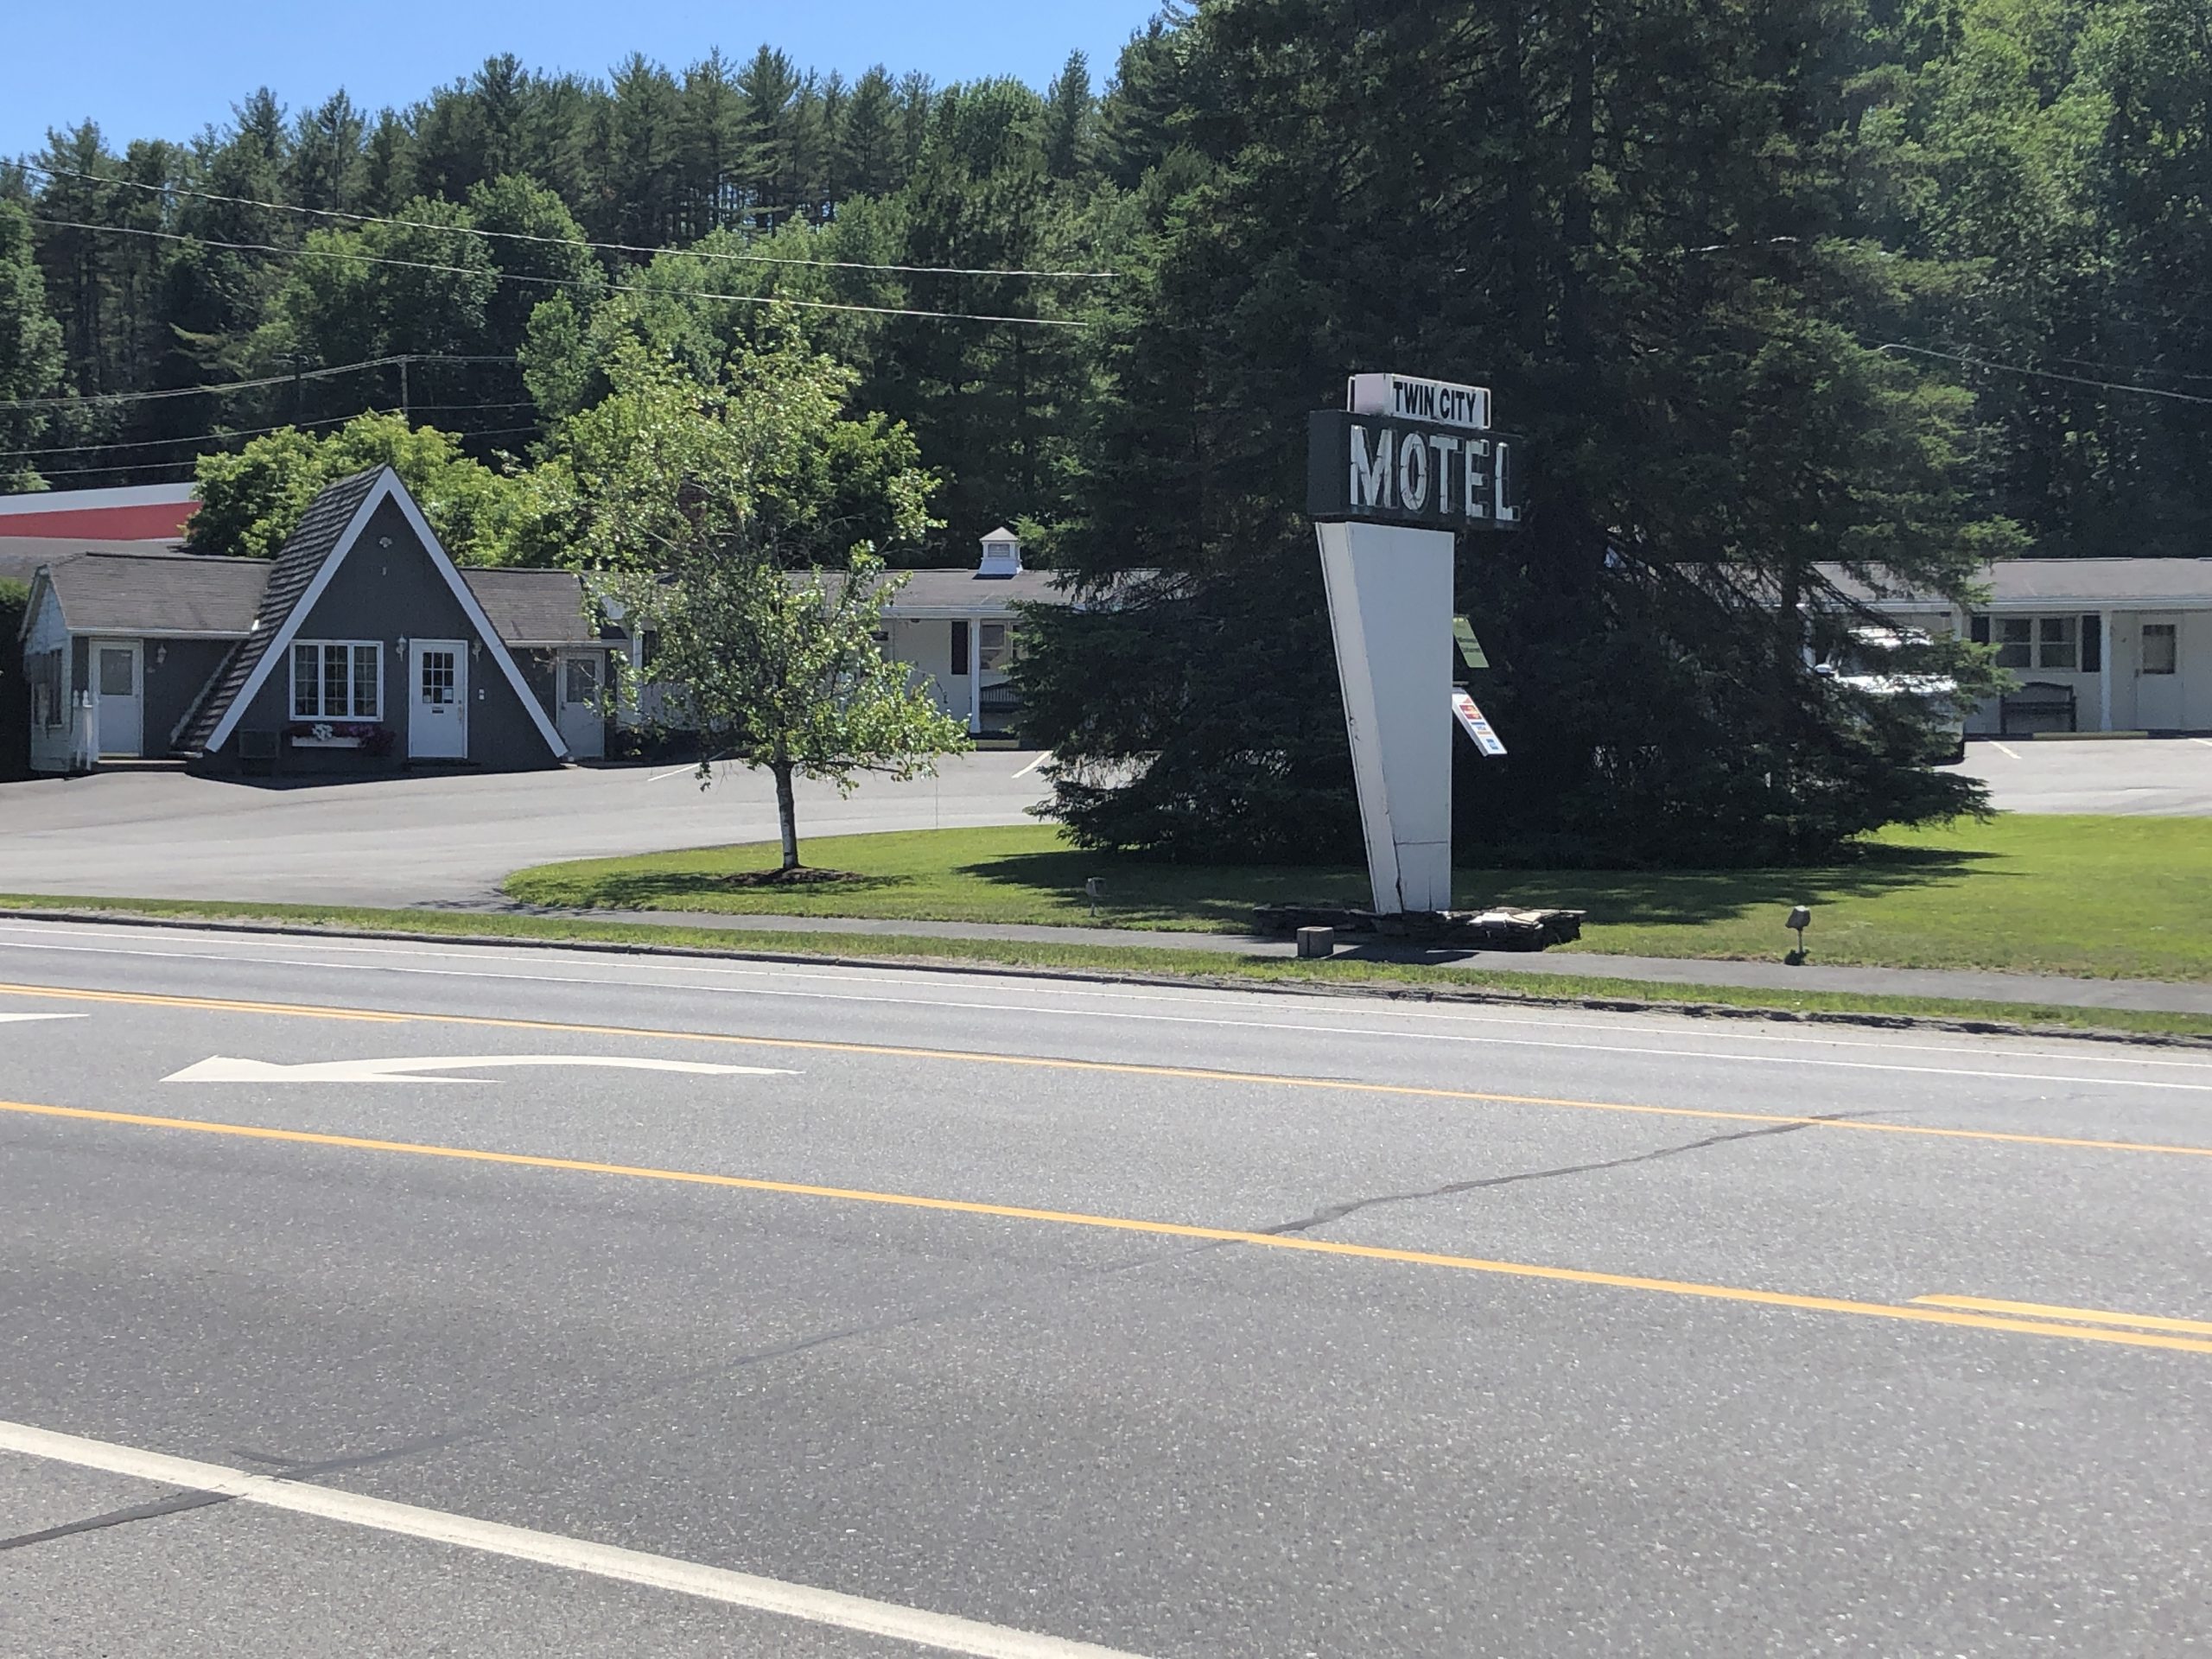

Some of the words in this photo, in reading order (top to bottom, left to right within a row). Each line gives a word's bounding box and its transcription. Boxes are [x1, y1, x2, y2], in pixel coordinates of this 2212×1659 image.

[1393, 381, 1435, 418] TWIN
[1439, 387, 1477, 423] CITY
[1350, 424, 1517, 521] MOTEL
